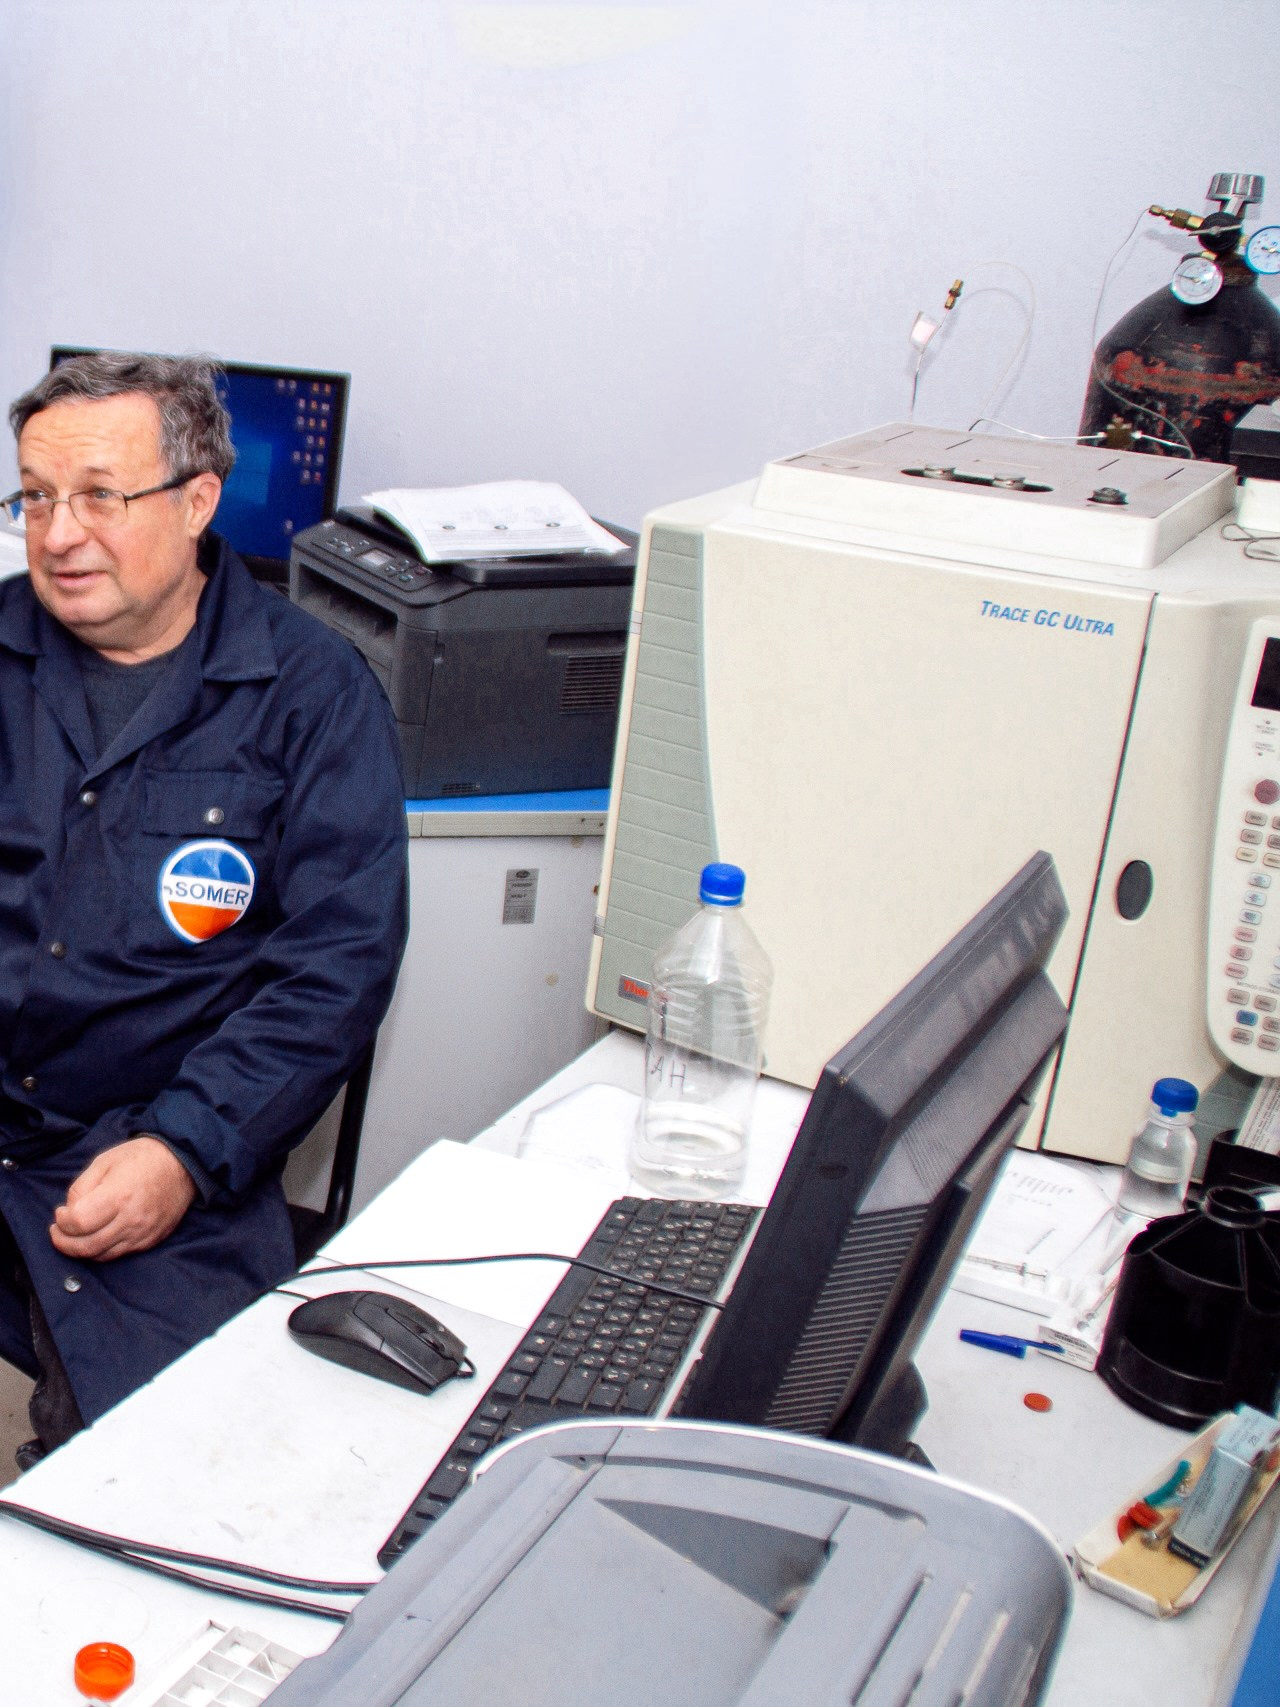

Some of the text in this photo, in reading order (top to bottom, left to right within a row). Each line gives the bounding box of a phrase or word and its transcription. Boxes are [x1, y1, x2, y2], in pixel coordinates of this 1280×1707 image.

[981, 600, 1115, 636] TRACE GC ULTRA
